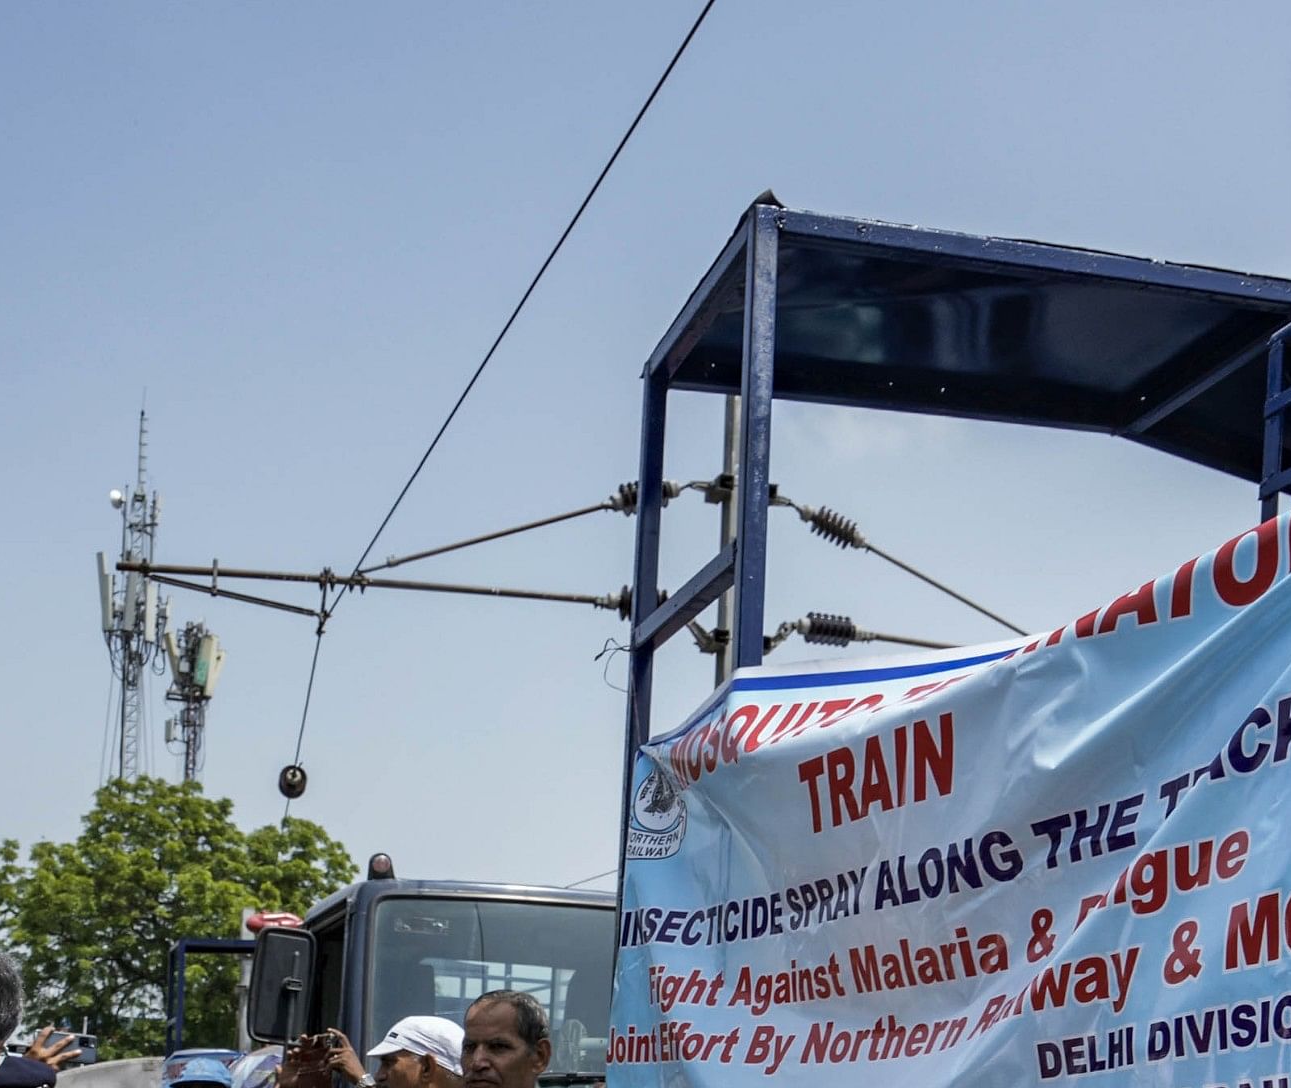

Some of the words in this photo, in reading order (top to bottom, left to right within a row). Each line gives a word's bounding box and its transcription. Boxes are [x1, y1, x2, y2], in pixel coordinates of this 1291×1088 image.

[799, 712, 954, 833] TRAIN
[621, 892, 783, 947] INSECTICIDE
[786, 867, 868, 931] SPRAY
[874, 830, 1024, 911] ALONG
[1031, 793, 1145, 869] THE
[607, 1026, 657, 1064] Joint
[661, 1022, 741, 1065] Effort
[744, 1025, 794, 1076] By
[800, 1014, 969, 1065] Northern
[1164, 921, 1202, 985] &
[649, 965, 724, 1013] Fight
[728, 951, 845, 1016] Against
[849, 926, 1008, 995] Malaria
[1027, 907, 1056, 963] &
[1036, 1028, 1134, 1079] DELHI
